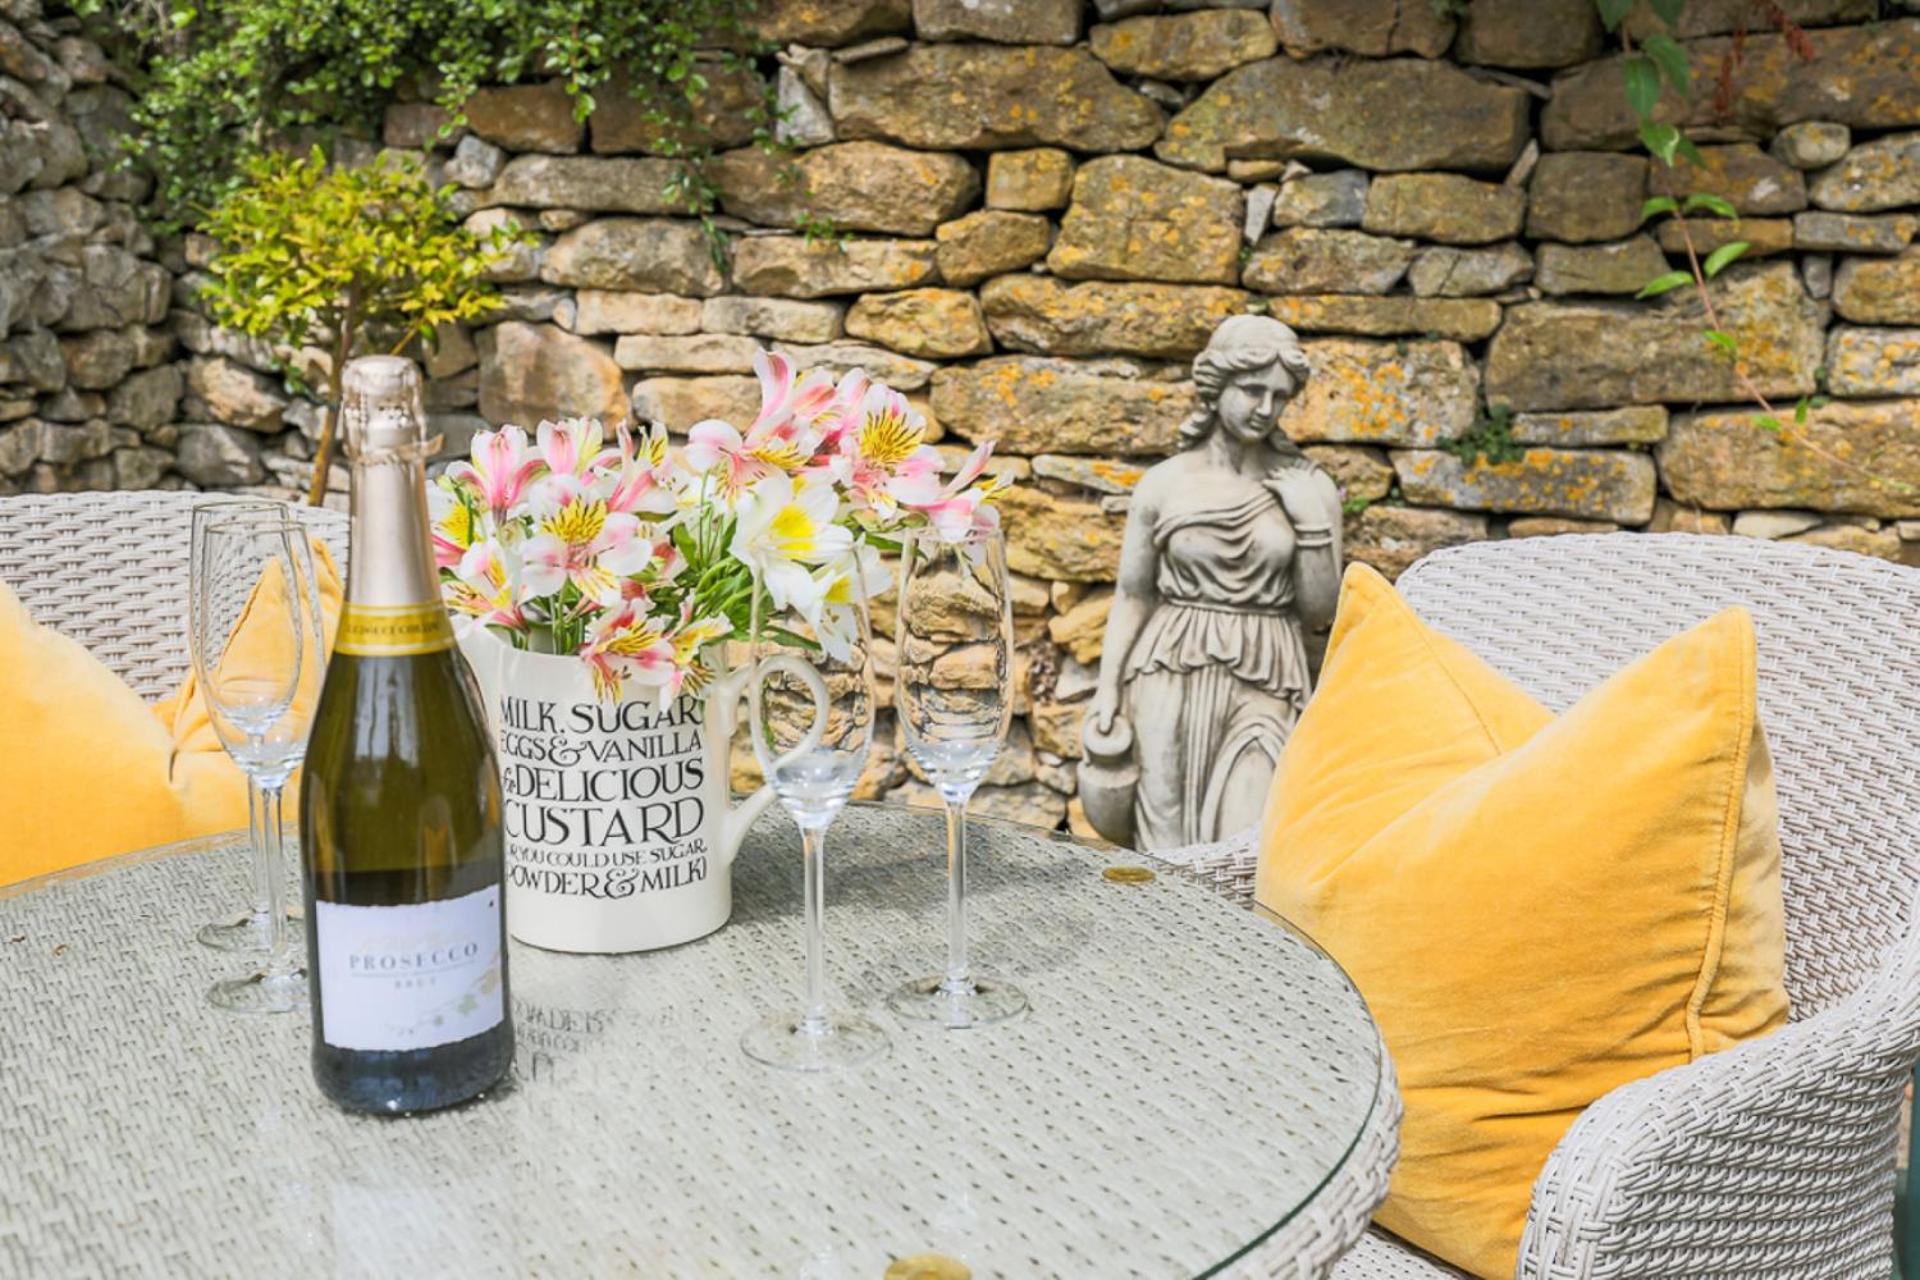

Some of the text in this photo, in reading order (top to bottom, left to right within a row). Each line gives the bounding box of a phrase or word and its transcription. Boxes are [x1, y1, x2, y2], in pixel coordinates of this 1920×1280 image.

[567, 693, 704, 734] SUGAR
[585, 728, 702, 763] VANILLA
[515, 758, 704, 803] DELICIOUS
[505, 797, 705, 847] CUSTARD
[546, 851, 610, 868] COULD
[612, 850, 648, 866] USE
[349, 942, 478, 971] PROSECCO
